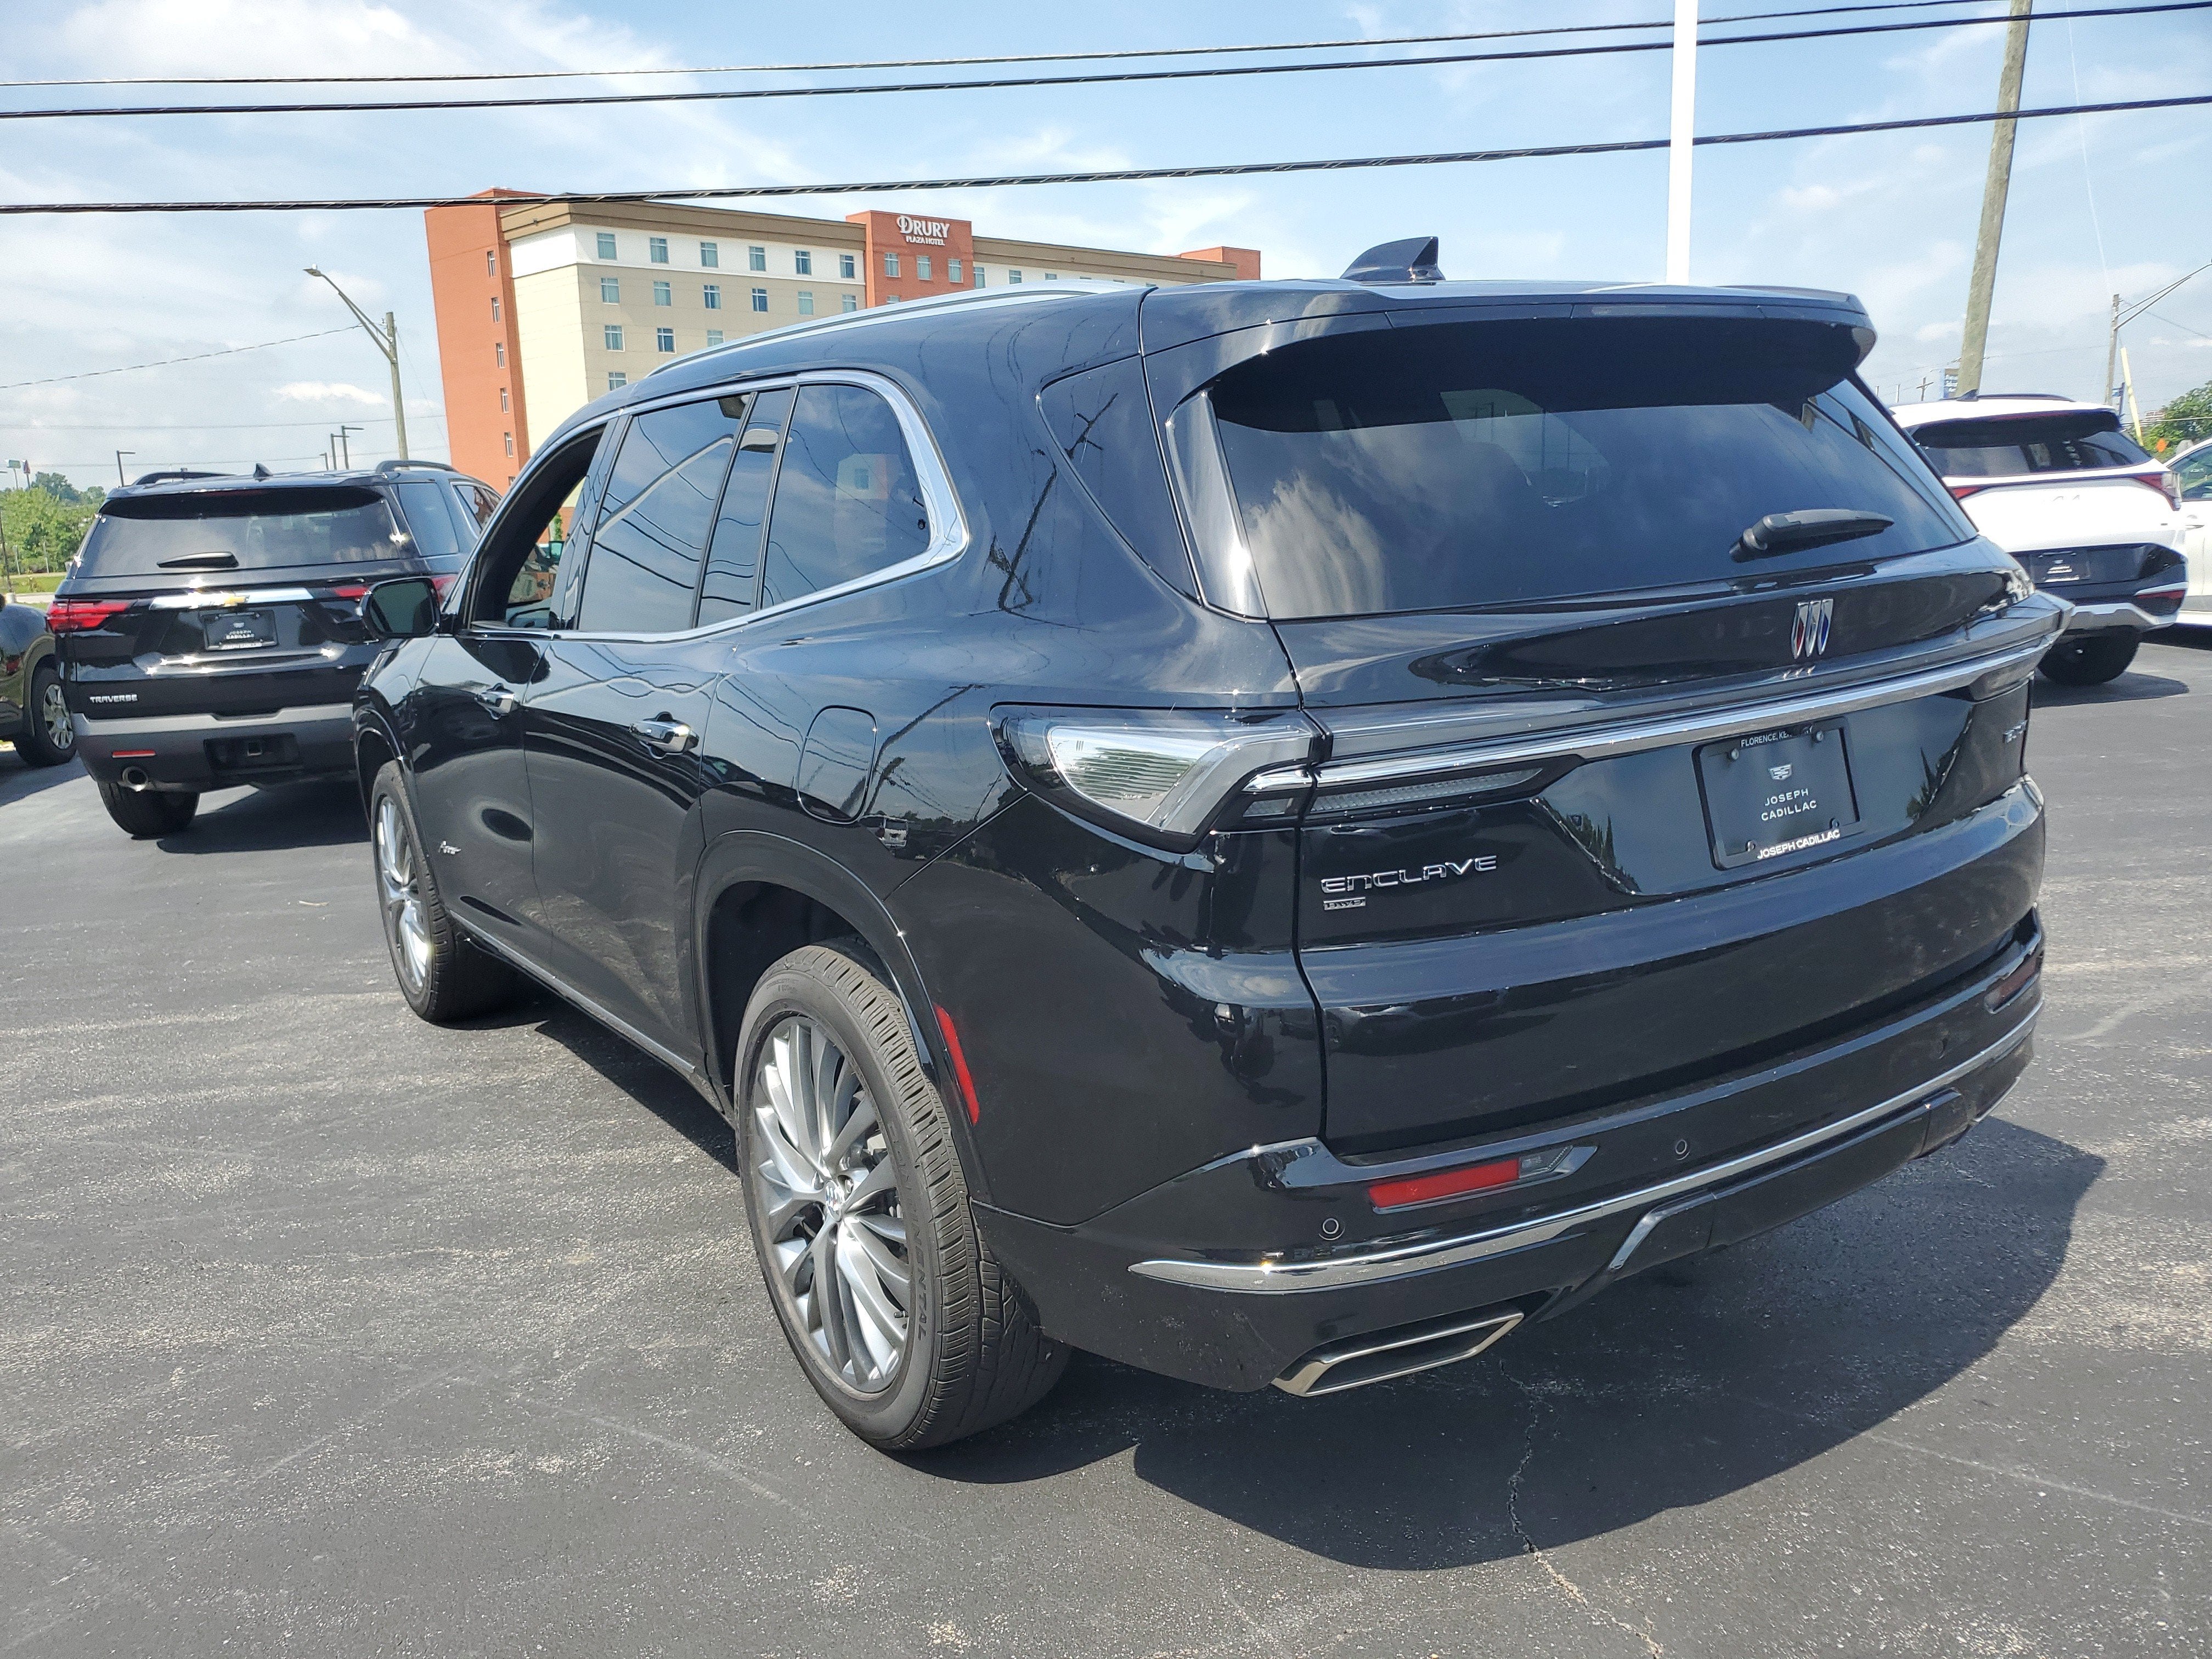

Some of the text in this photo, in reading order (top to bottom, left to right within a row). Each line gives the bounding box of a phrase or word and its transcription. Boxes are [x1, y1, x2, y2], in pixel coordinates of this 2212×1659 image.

[896, 216, 950, 238] DRURY
[905, 236, 945, 246] PLAZA HOTEL
[89, 694, 138, 703] TRAVERSE
[1741, 732, 1778, 748] FLORENCE,
[1764, 788, 1809, 806] JOSEPH
[1760, 800, 1818, 821] CADILLAC
[1757, 828, 1841, 860] JOSEPH CADILLAC
[1321, 855, 1497, 894] ENCLAVE
[1324, 898, 1365, 910] AWD
